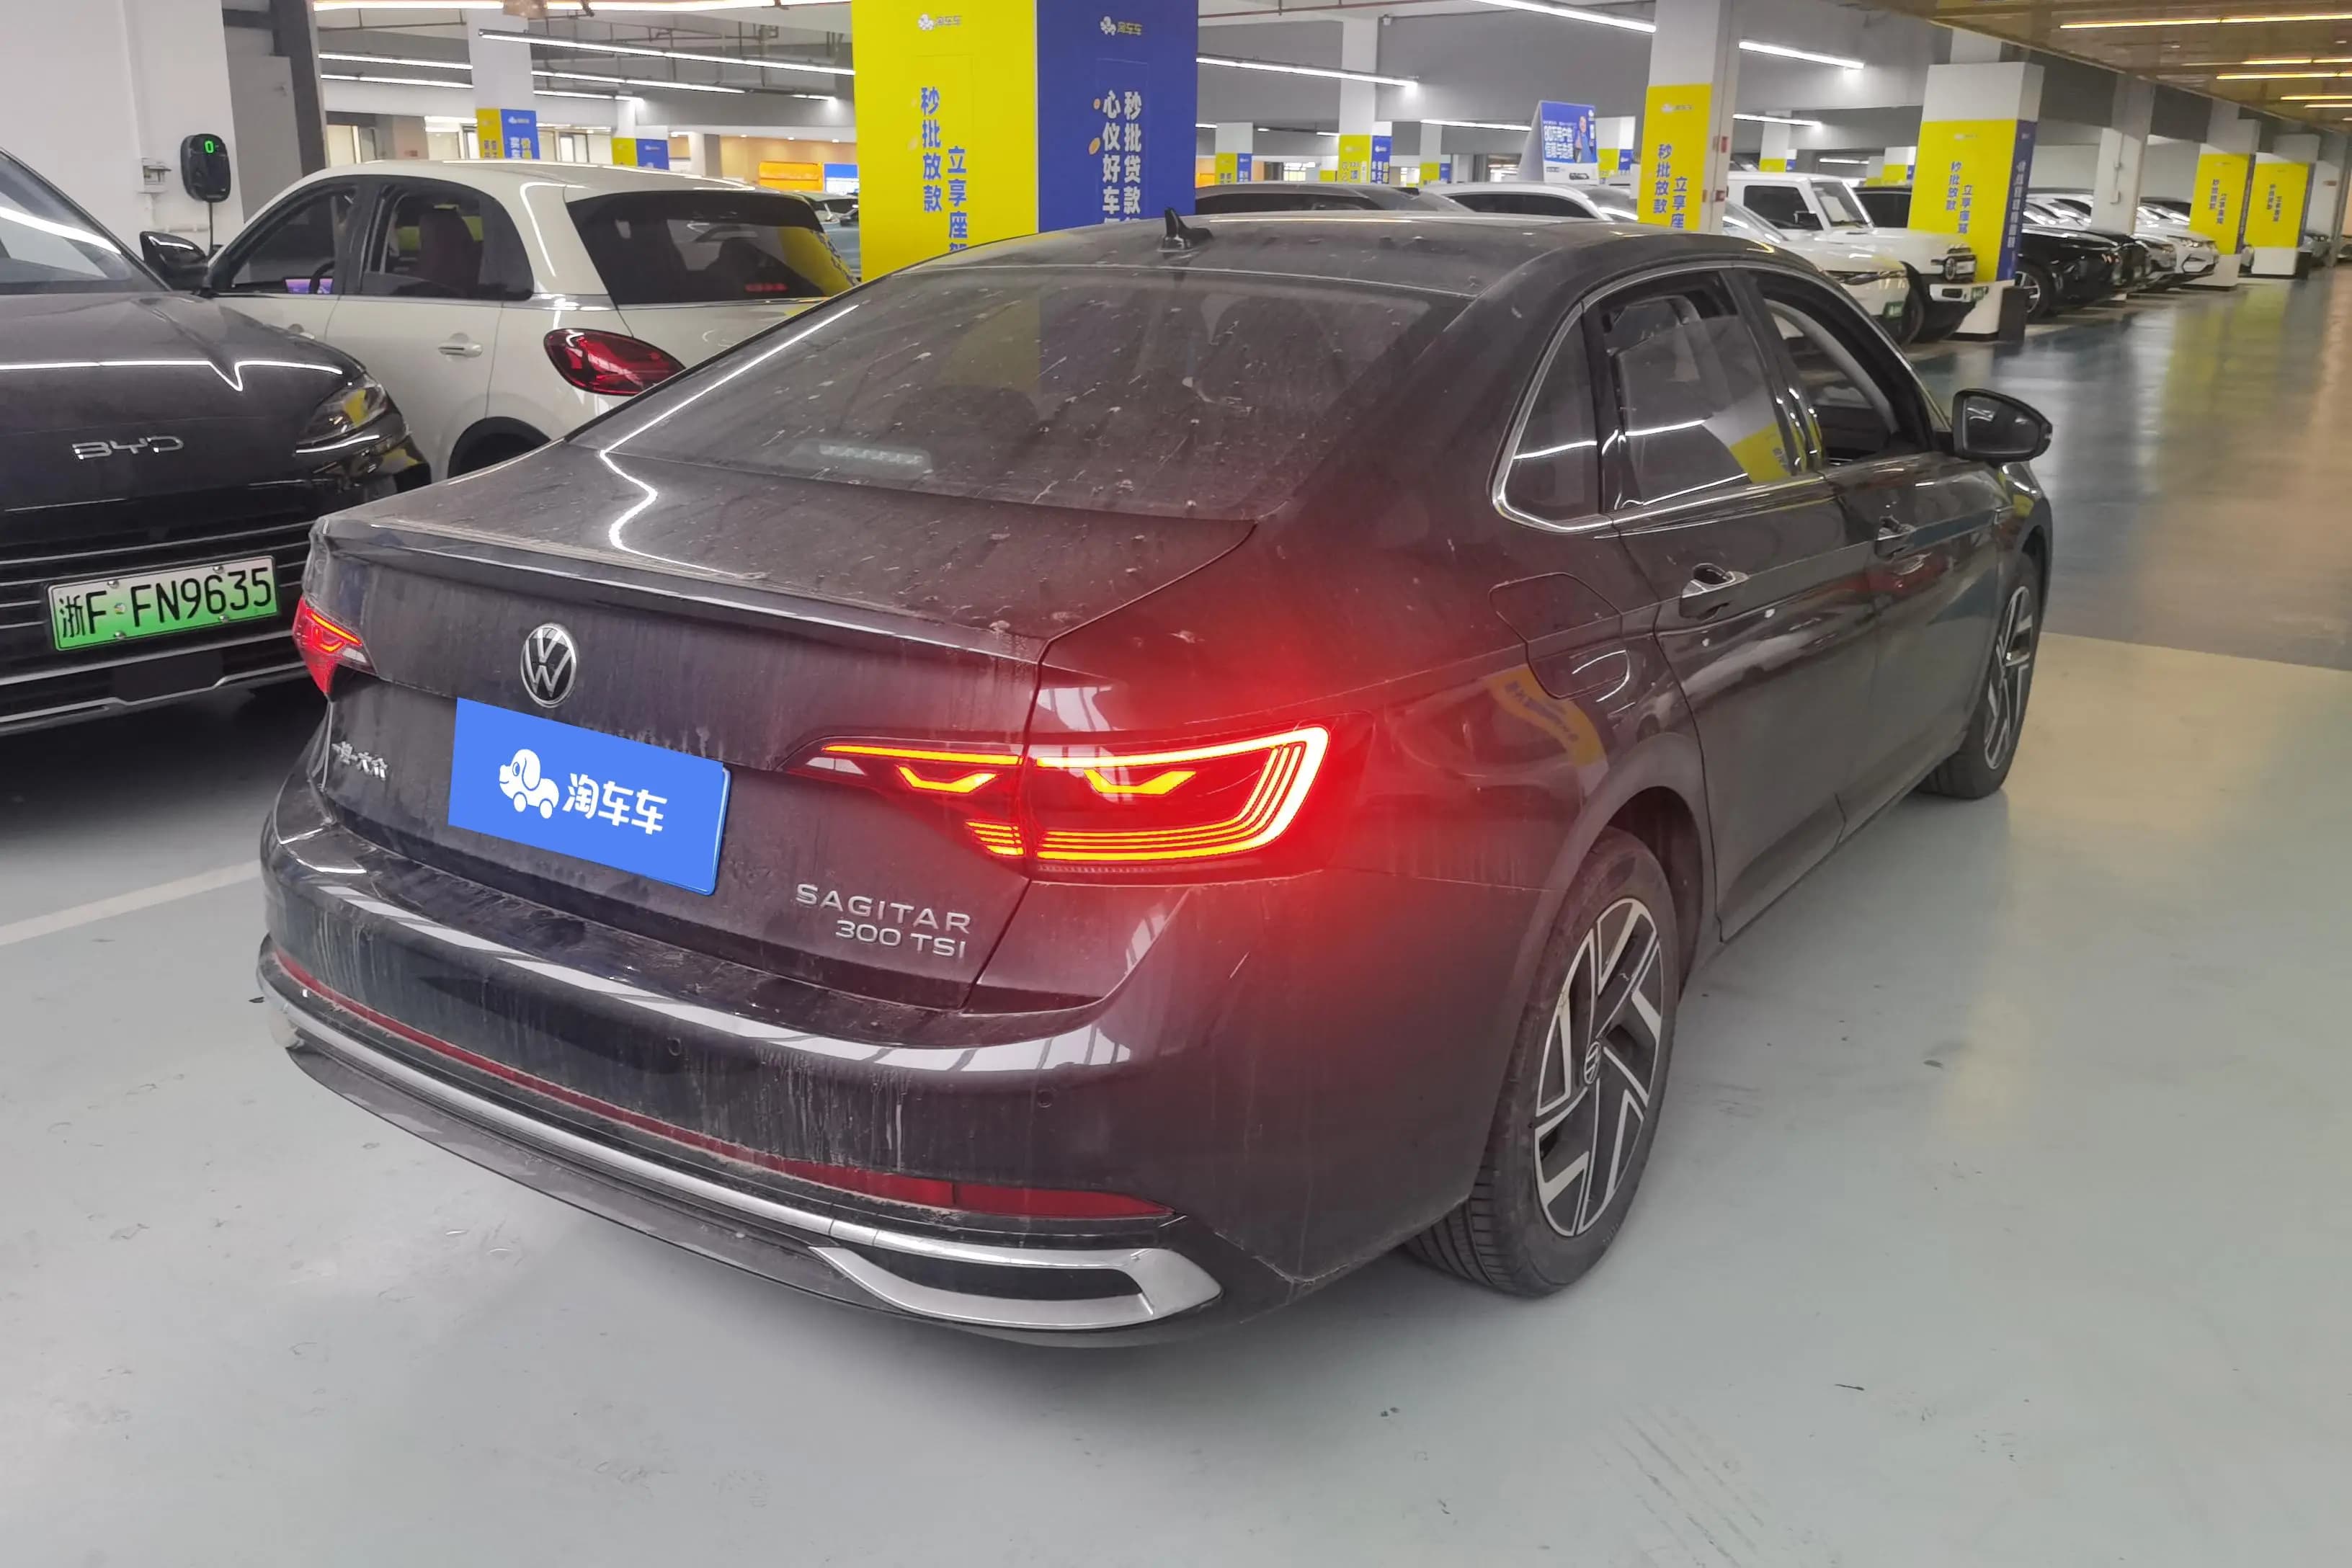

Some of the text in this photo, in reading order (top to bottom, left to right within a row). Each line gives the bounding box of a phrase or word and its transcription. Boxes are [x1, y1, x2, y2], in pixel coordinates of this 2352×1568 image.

[921, 86, 942, 212] 秒批放款
[1102, 90, 1121, 223] 心仪好车
[1123, 92, 1142, 222] 秒批贷款
[1653, 144, 1672, 213] 秒批放款
[72, 436, 184, 460] BYD
[130, 567, 272, 628] FN9635
[796, 883, 971, 934] SAGITAR
[836, 919, 966, 960] 300 TSI
